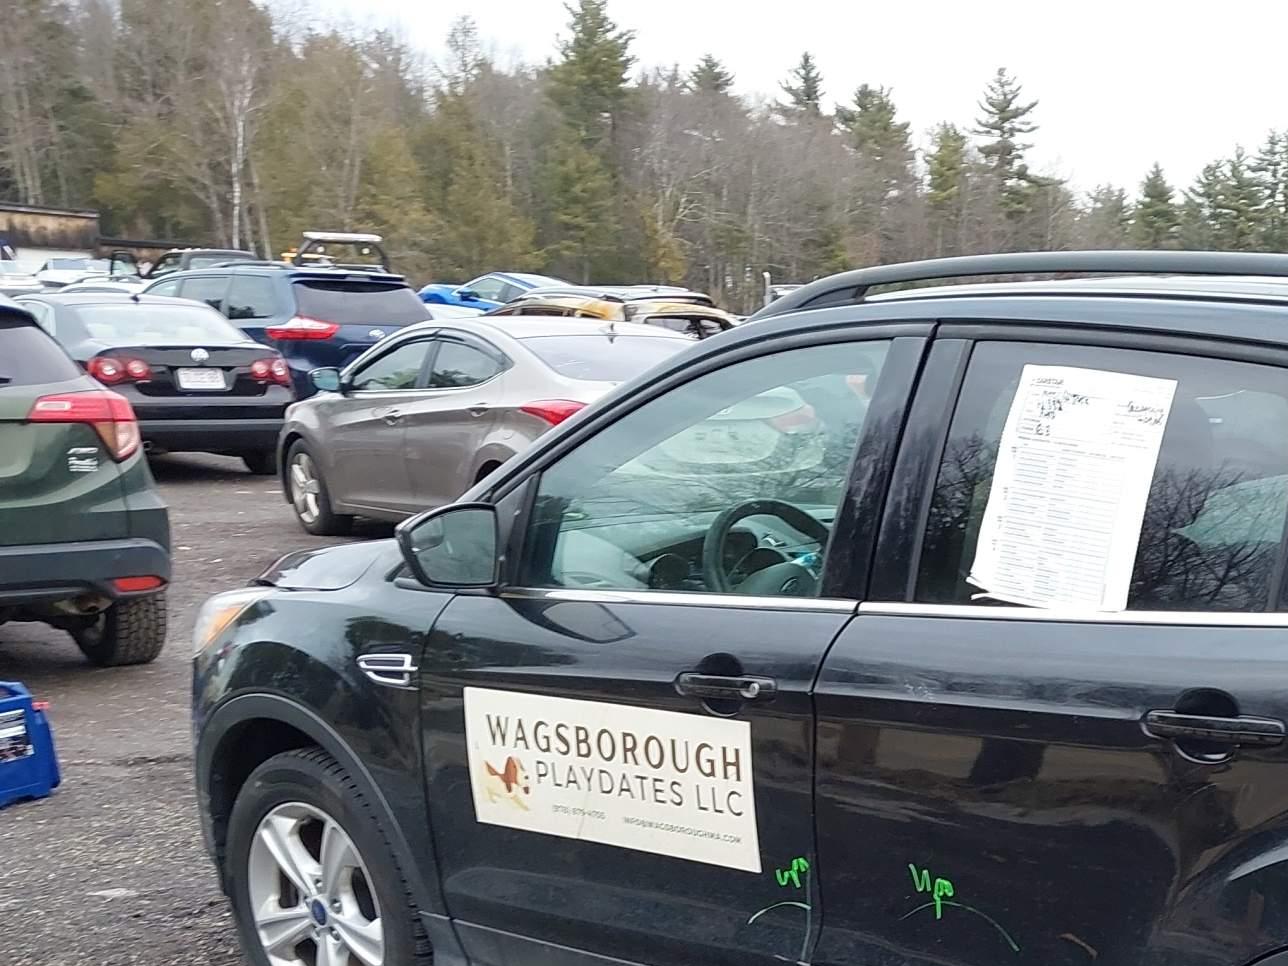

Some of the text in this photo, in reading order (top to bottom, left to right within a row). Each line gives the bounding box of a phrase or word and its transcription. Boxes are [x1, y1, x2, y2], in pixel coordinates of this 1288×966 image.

[485, 714, 742, 782] WAGSBOROUGH
[536, 760, 744, 817] PLAYDATES LLC
